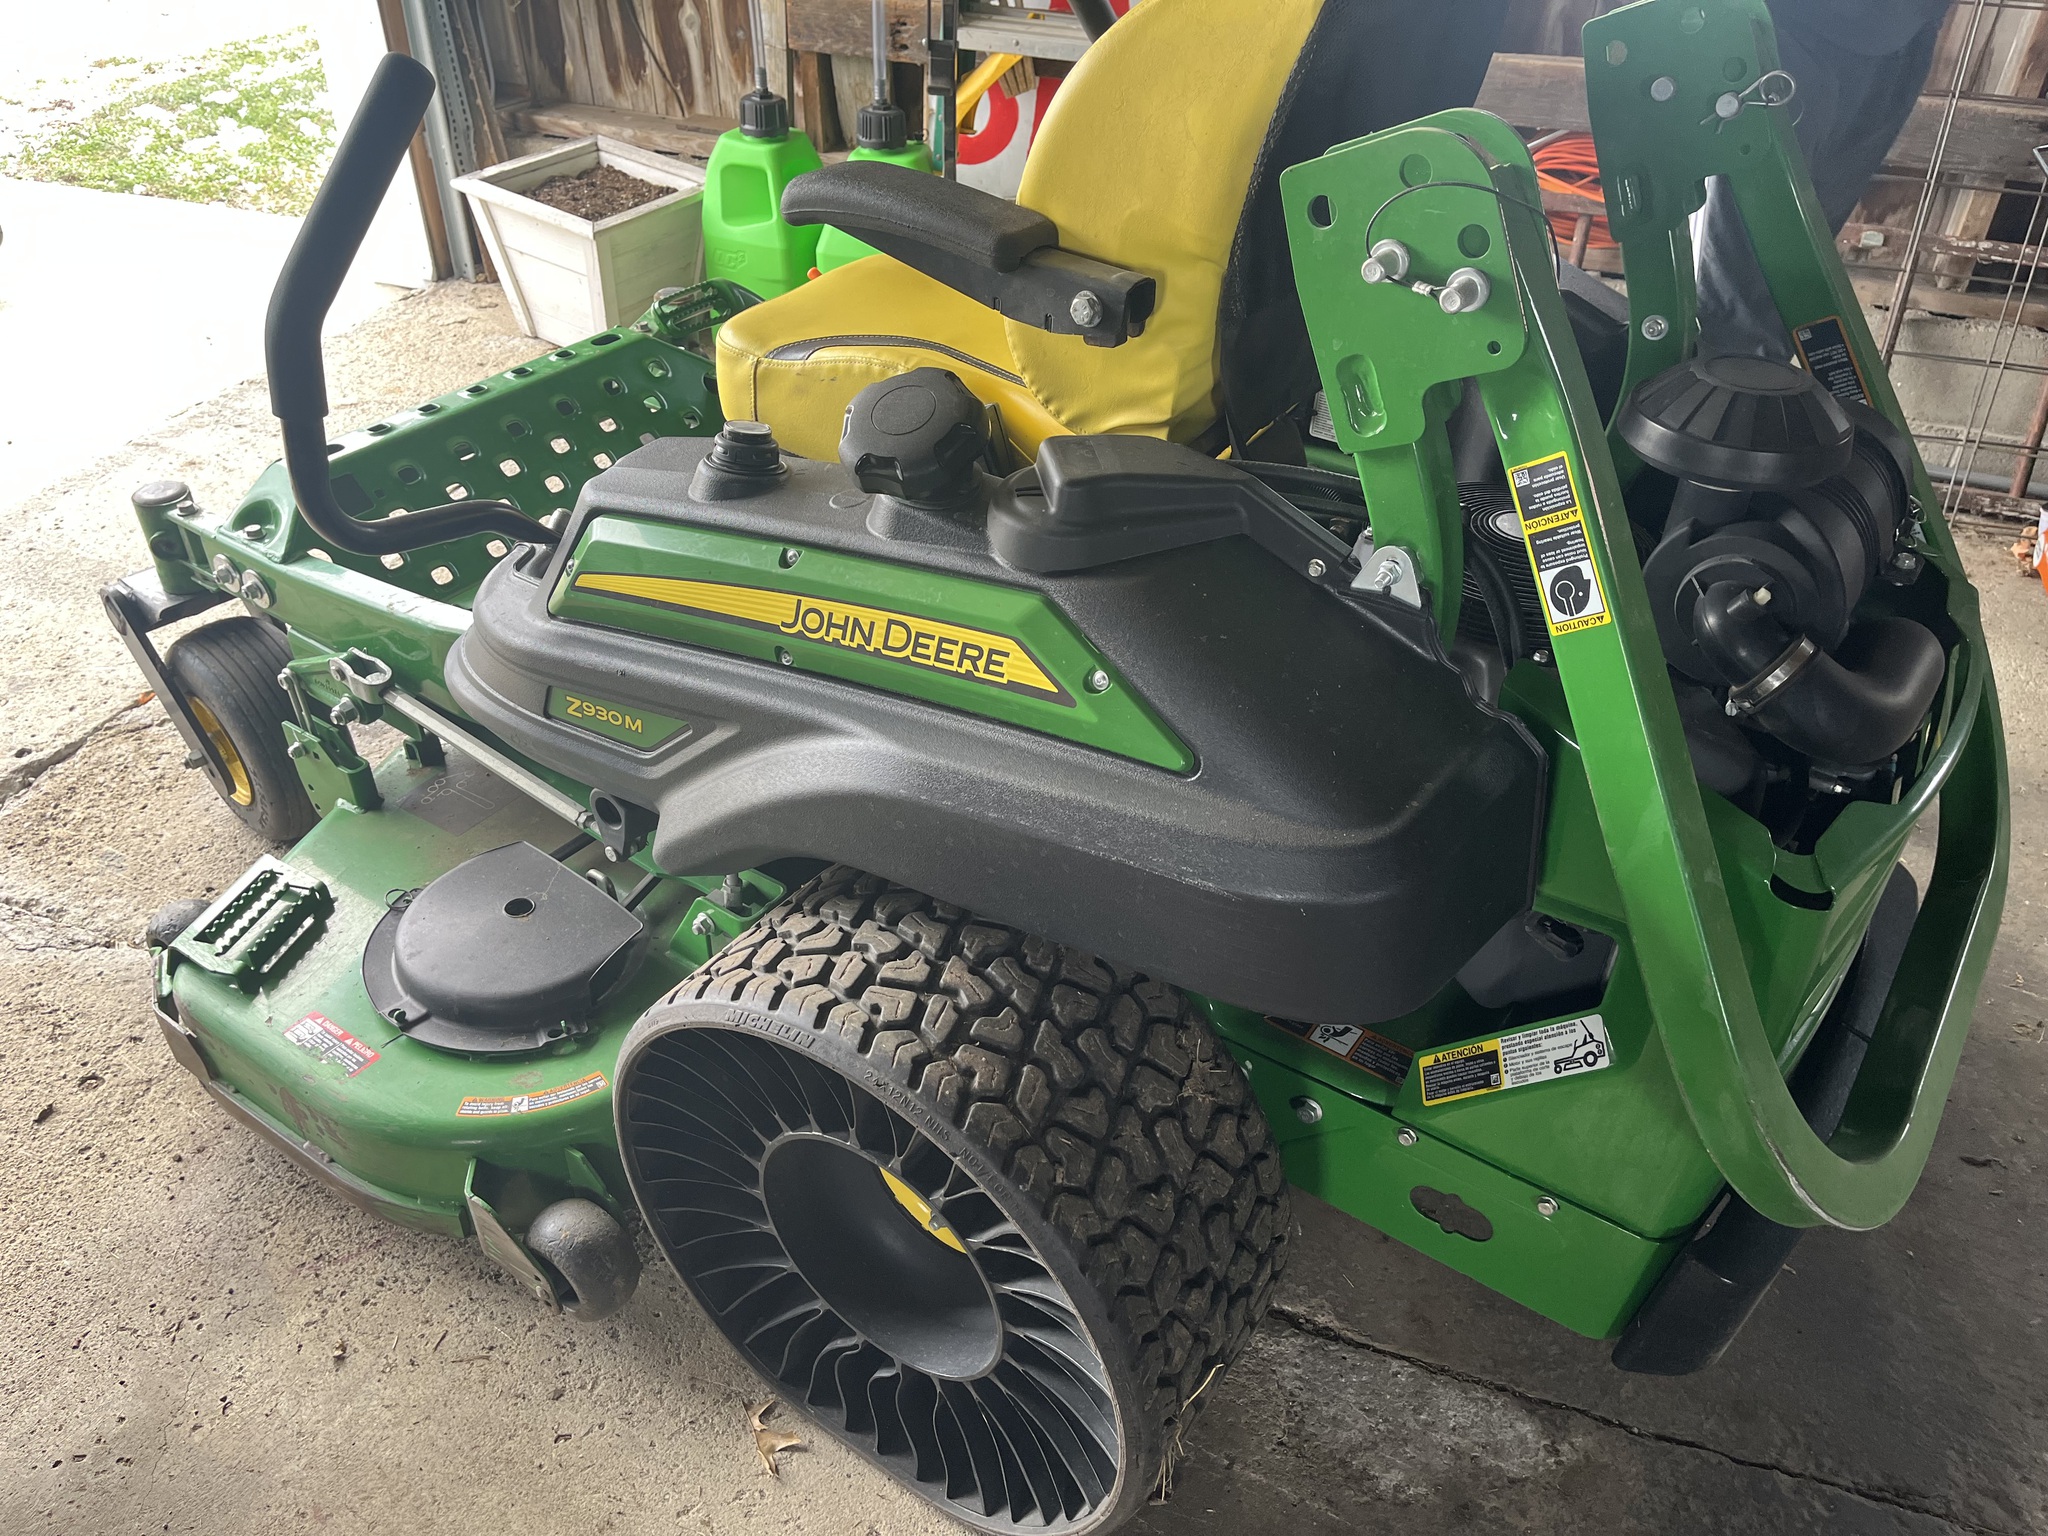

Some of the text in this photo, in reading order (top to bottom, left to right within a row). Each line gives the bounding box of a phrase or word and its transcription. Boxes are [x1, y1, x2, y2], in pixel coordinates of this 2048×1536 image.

[1524, 511, 1571, 532] ATENCIÓN
[1535, 536, 1552, 544] hearing
[1544, 558, 1565, 567] exposure
[1565, 552, 1588, 562] Prolonged
[1554, 616, 1597, 633] CAUTION
[780, 598, 1011, 680] JOHN DEERE
[565, 695, 643, 734] Z930M
[322, 1020, 344, 1036] DANGER
[724, 1008, 815, 1049] MICHELIN
[1500, 1034, 1517, 1043] Revisar
[1521, 1029, 1538, 1039] limpiar
[1501, 1040, 1523, 1051] prestando
[1523, 1034, 1543, 1045] especial
[1543, 1029, 1563, 1039] atención
[1502, 1041, 1543, 1056] puntos siguientes:
[1441, 1043, 1484, 1063] ATENCIÓN
